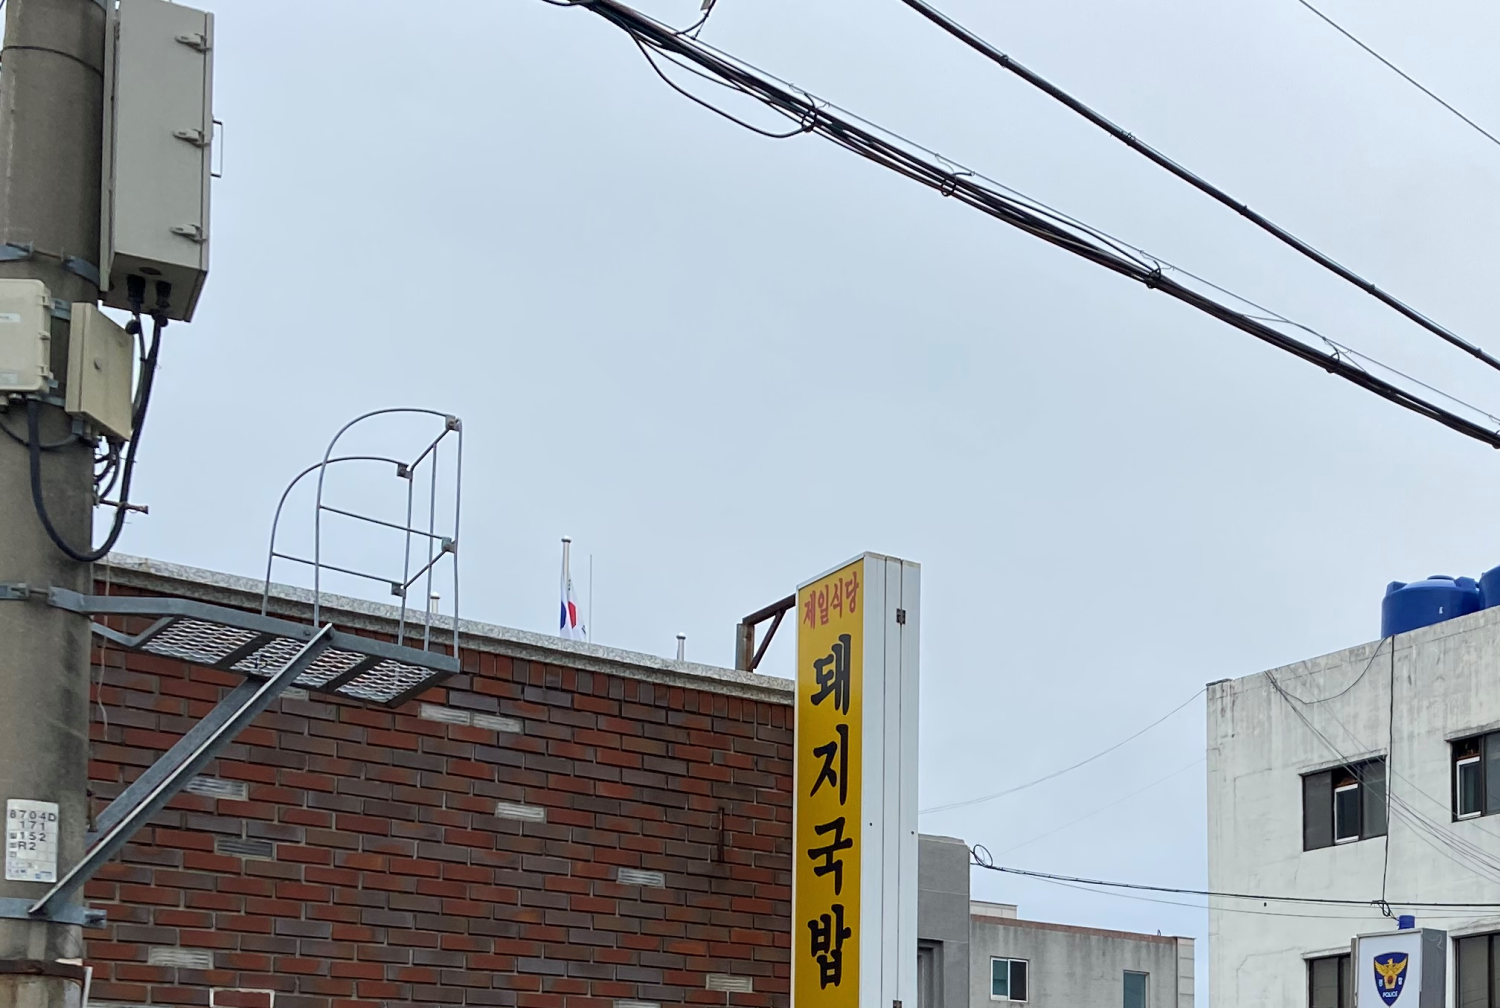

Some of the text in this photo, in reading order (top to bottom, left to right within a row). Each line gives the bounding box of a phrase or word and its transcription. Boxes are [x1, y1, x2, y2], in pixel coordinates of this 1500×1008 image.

[803, 570, 860, 630] 제일식당
[19, 820, 46, 831] 171
[807, 634, 854, 990] 돼지국밥
[20, 831, 46, 842] 152
